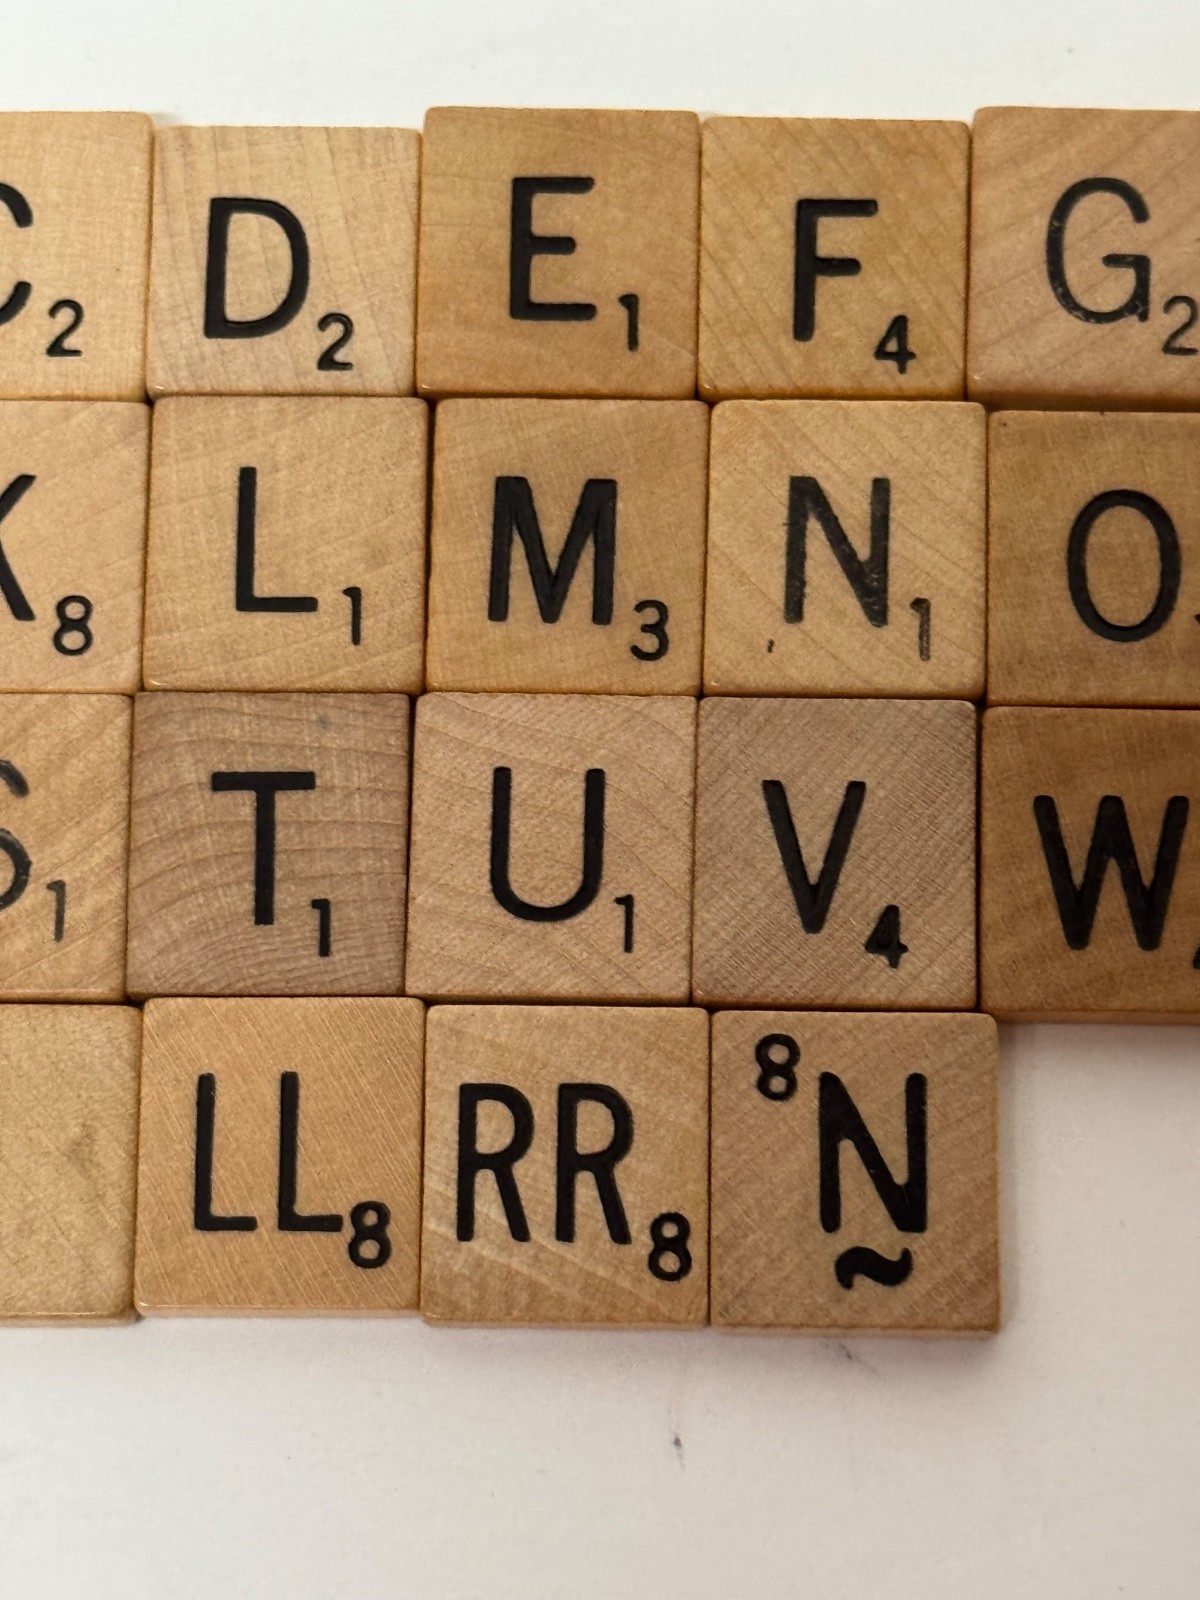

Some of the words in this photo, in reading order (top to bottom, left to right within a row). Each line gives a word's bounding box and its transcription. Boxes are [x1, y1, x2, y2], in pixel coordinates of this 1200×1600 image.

[46, 299, 84, 358] 2
[204, 196, 309, 339] D
[317, 313, 354, 370] 2
[509, 175, 597, 322] E
[617, 293, 639, 353] 1
[793, 198, 879, 343] F
[874, 315, 916, 375] 4
[1046, 176, 1152, 325] G
[1161, 296, 1199, 357] 2
[53, 594, 93, 657] 8
[236, 467, 319, 613] L
[342, 586, 363, 646] 1
[488, 475, 618, 626] M
[629, 600, 670, 662] 3
[784, 475, 892, 629] N
[909, 597, 932, 662] 1
[1066, 488, 1182, 645] O
[46, 879, 66, 943] 1
[210, 770, 317, 927] T
[309, 898, 333, 958] 1
[489, 766, 607, 923] U
[613, 893, 635, 954] 1
[761, 780, 867, 935] V
[862, 902, 909, 969] 4
[1033, 794, 1191, 952] W
[754, 1033, 802, 1103] 8
[193, 1071, 343, 1233] LL
[347, 1201, 393, 1270] 8
[456, 1082, 635, 1246] RR
[646, 1212, 693, 1284] 8
